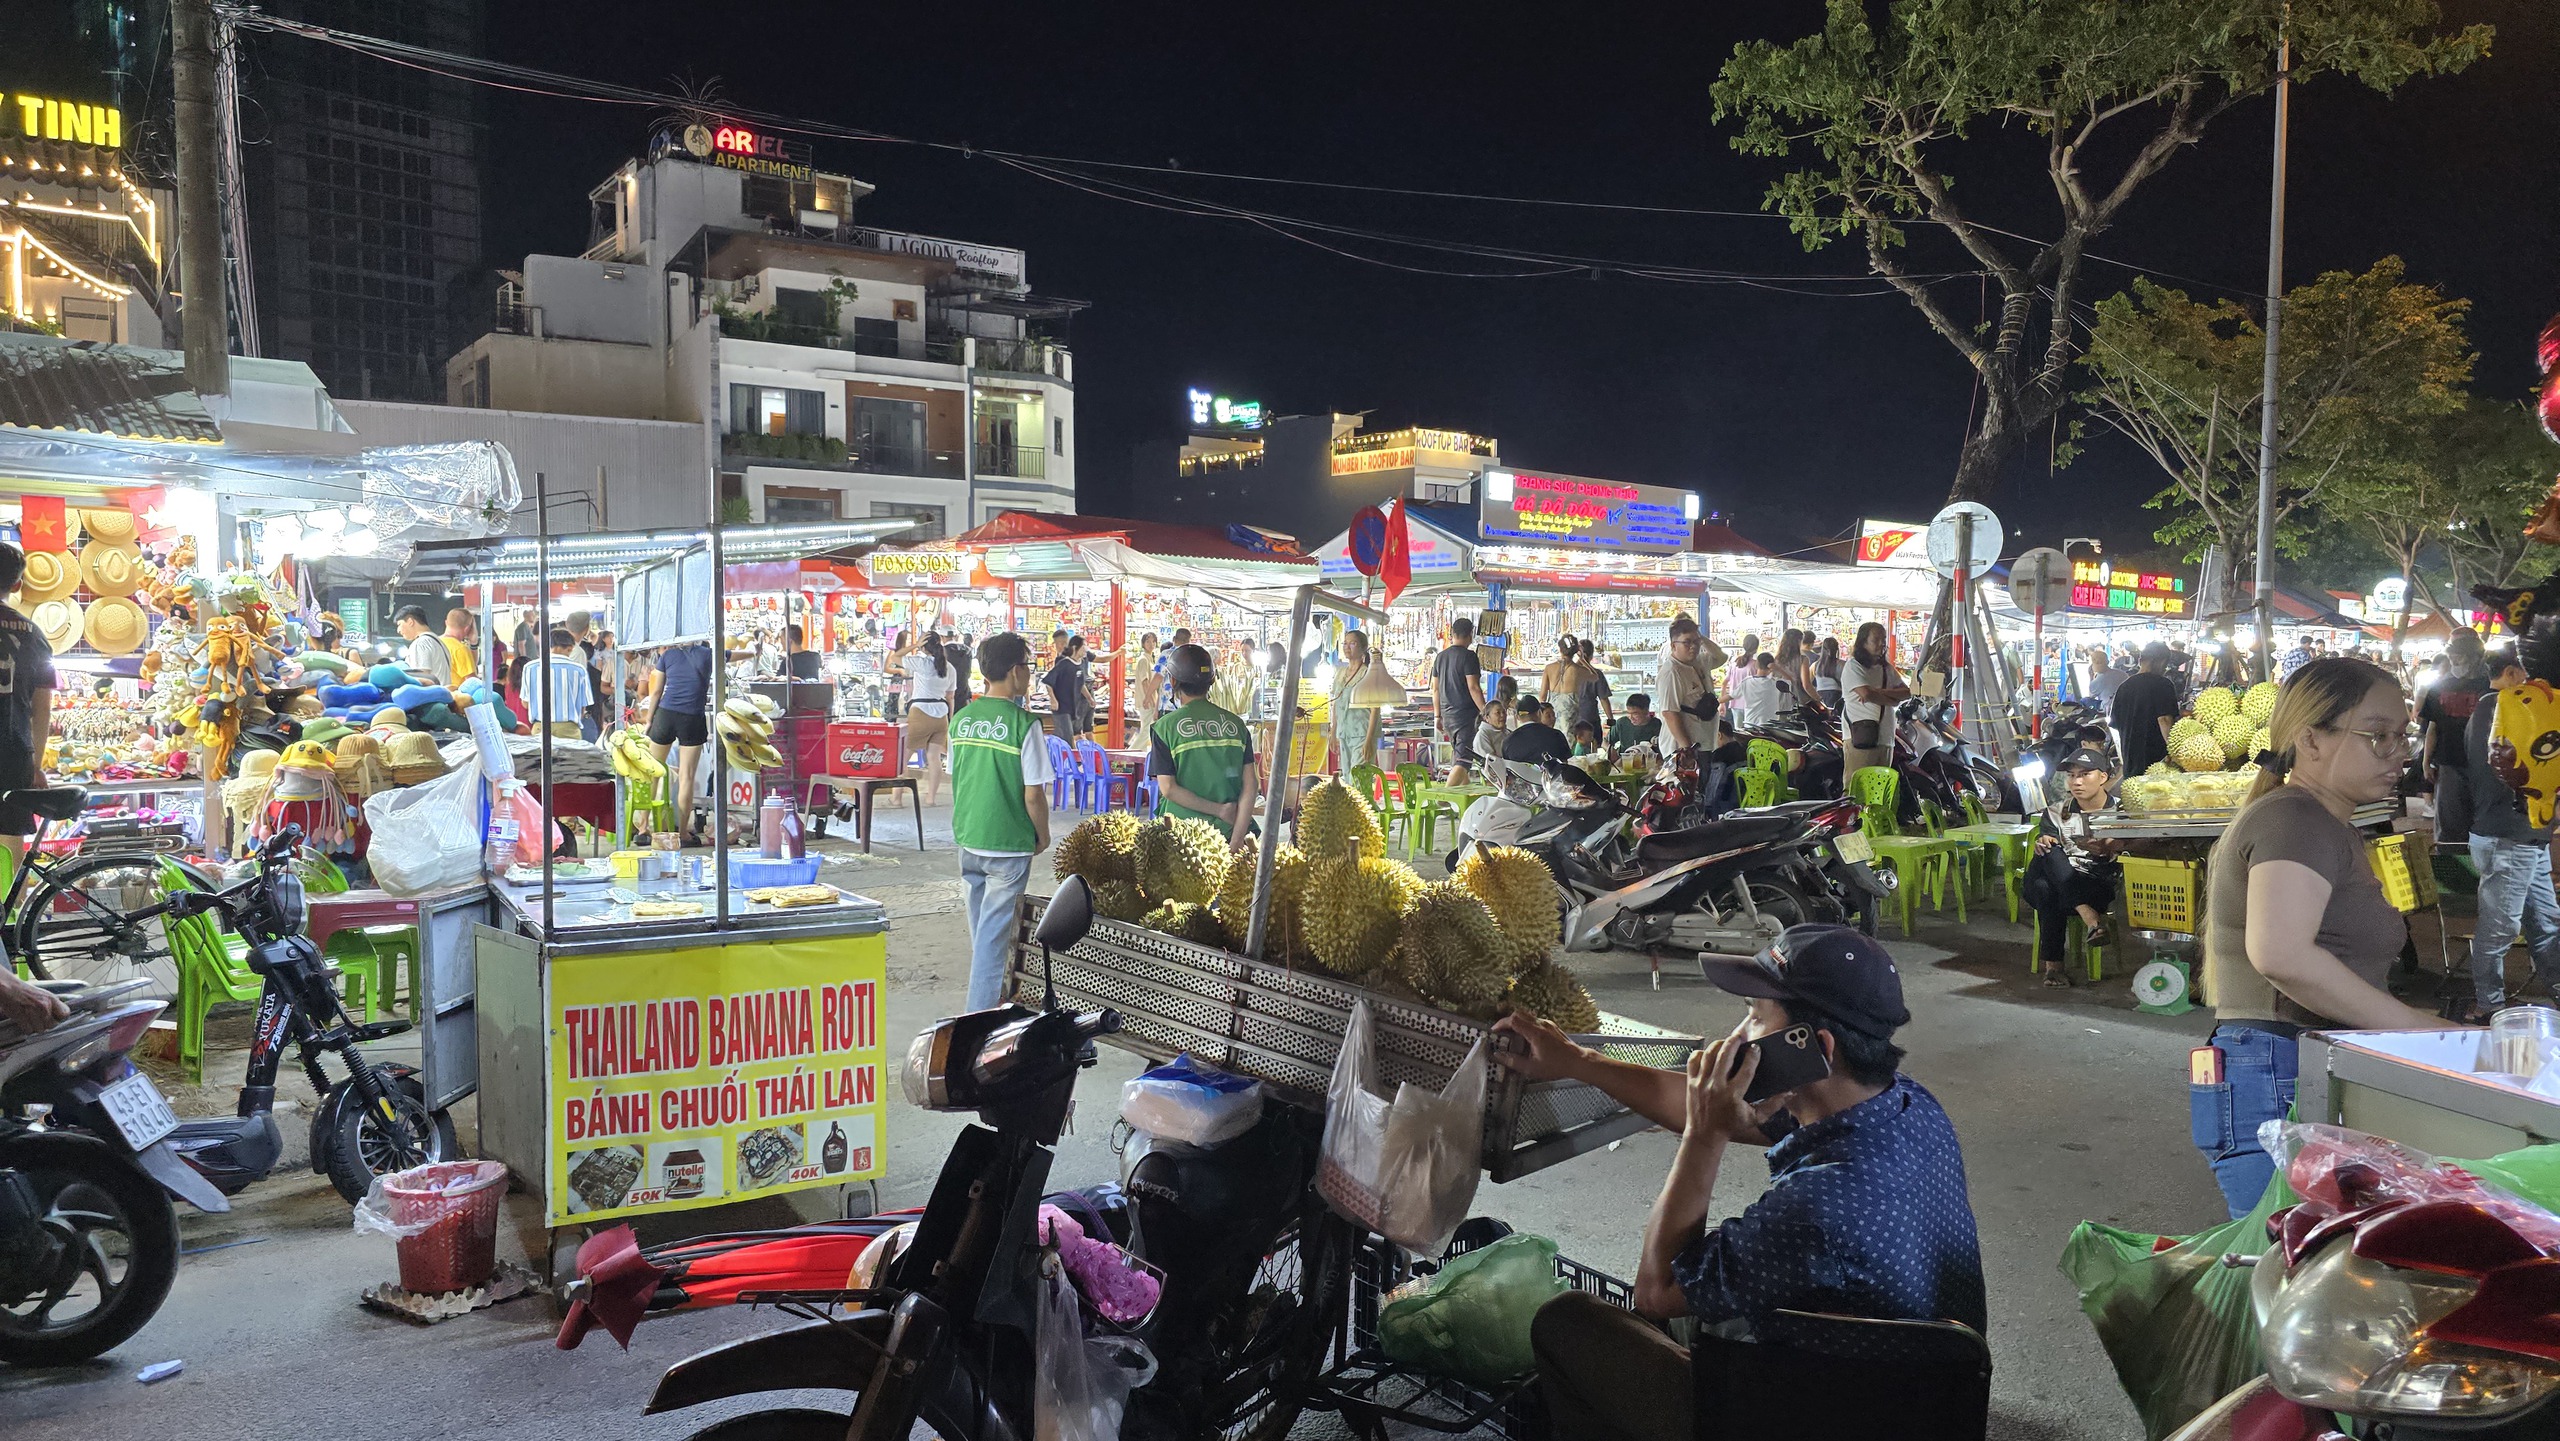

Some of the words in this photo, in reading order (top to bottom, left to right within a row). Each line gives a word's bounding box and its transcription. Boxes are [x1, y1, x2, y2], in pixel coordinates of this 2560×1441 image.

[716, 127, 789, 158] ARIEL
[714, 152, 812, 182] APARTMENT
[888, 236, 954, 258] LAGOON
[956, 249, 999, 268] Rooftop
[1453, 434, 1469, 454] BAR
[1332, 456, 1359, 475] NUMBER
[1367, 454, 1399, 472] ROOFTOP
[1400, 451, 1415, 467] BAR
[957, 716, 1008, 740] Grab
[1177, 714, 1238, 738] Grab
[840, 747, 885, 764] Coca-Cola
[259, 993, 276, 1041] YUKATA
[565, 1000, 699, 1079] THAILAND
[709, 988, 814, 1067] BANANA
[822, 982, 876, 1052] ROTI
[110, 1082, 153, 1117] 43-E1
[566, 1088, 649, 1141] BÁNH
[661, 1069, 747, 1130] CHUỐI
[755, 1066, 815, 1118] THÁI
[824, 1065, 875, 1109] LAN
[121, 1103, 174, 1144] 519.40
[668, 1164, 704, 1179] nutella
[790, 1166, 819, 1180] 40K
[630, 1189, 662, 1204] 50K
